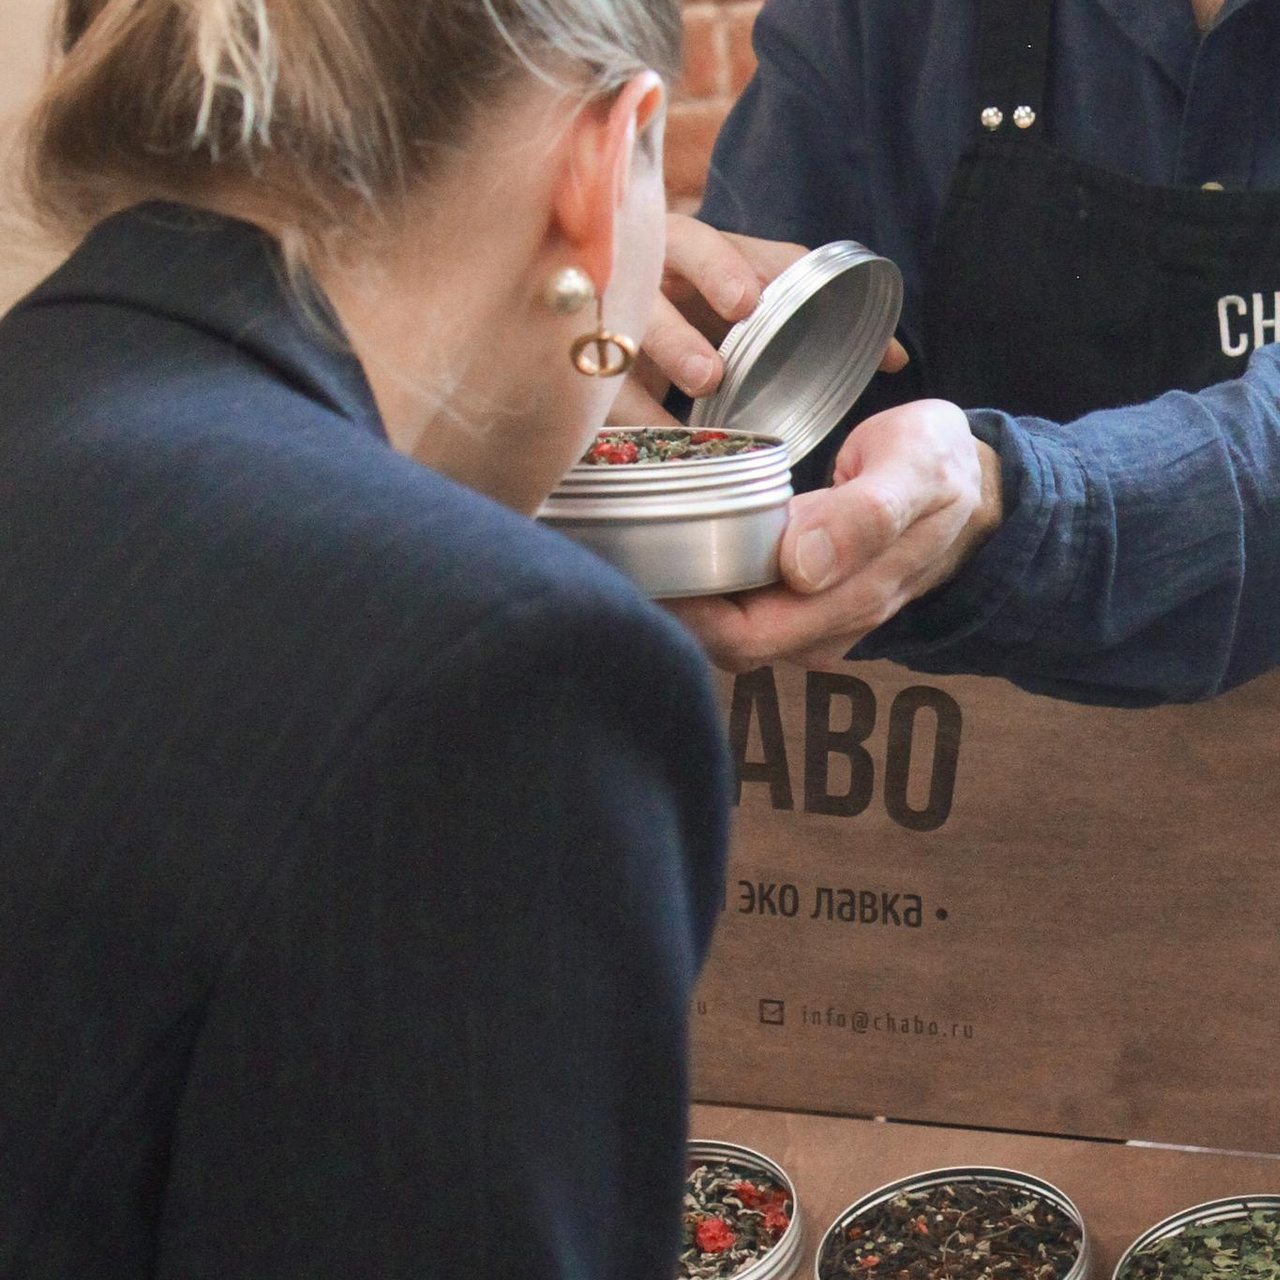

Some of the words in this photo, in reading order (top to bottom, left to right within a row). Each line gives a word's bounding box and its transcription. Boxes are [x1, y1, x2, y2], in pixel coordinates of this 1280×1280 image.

[729, 666, 963, 832] ABO
[738, 880, 799, 917] эко
[810, 887, 922, 927] лавка
[802, 1005, 973, 1039] info@chabo.ru
